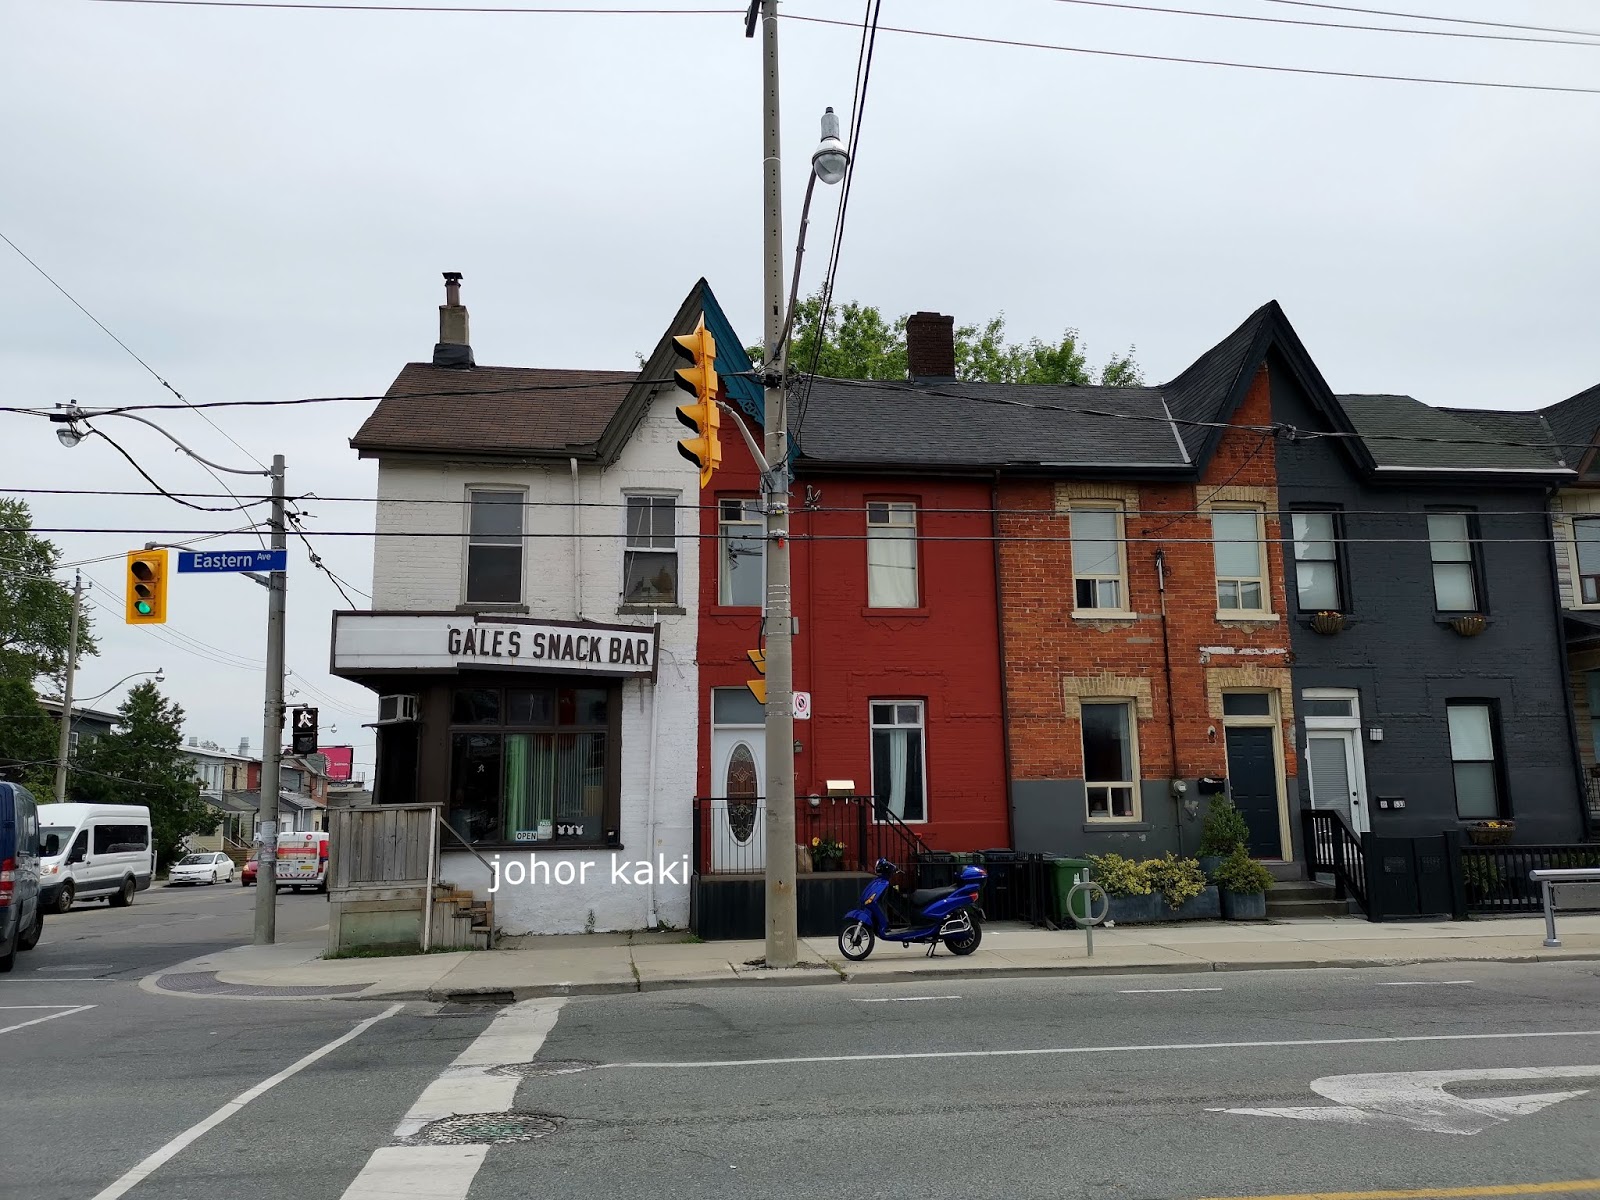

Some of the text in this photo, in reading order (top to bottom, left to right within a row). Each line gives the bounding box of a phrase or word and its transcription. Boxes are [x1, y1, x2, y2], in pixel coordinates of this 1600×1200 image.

[193, 552, 271, 568] Eastern Ave
[448, 628, 649, 665] GALES SNACK BAR
[516, 832, 536, 840] OPEN
